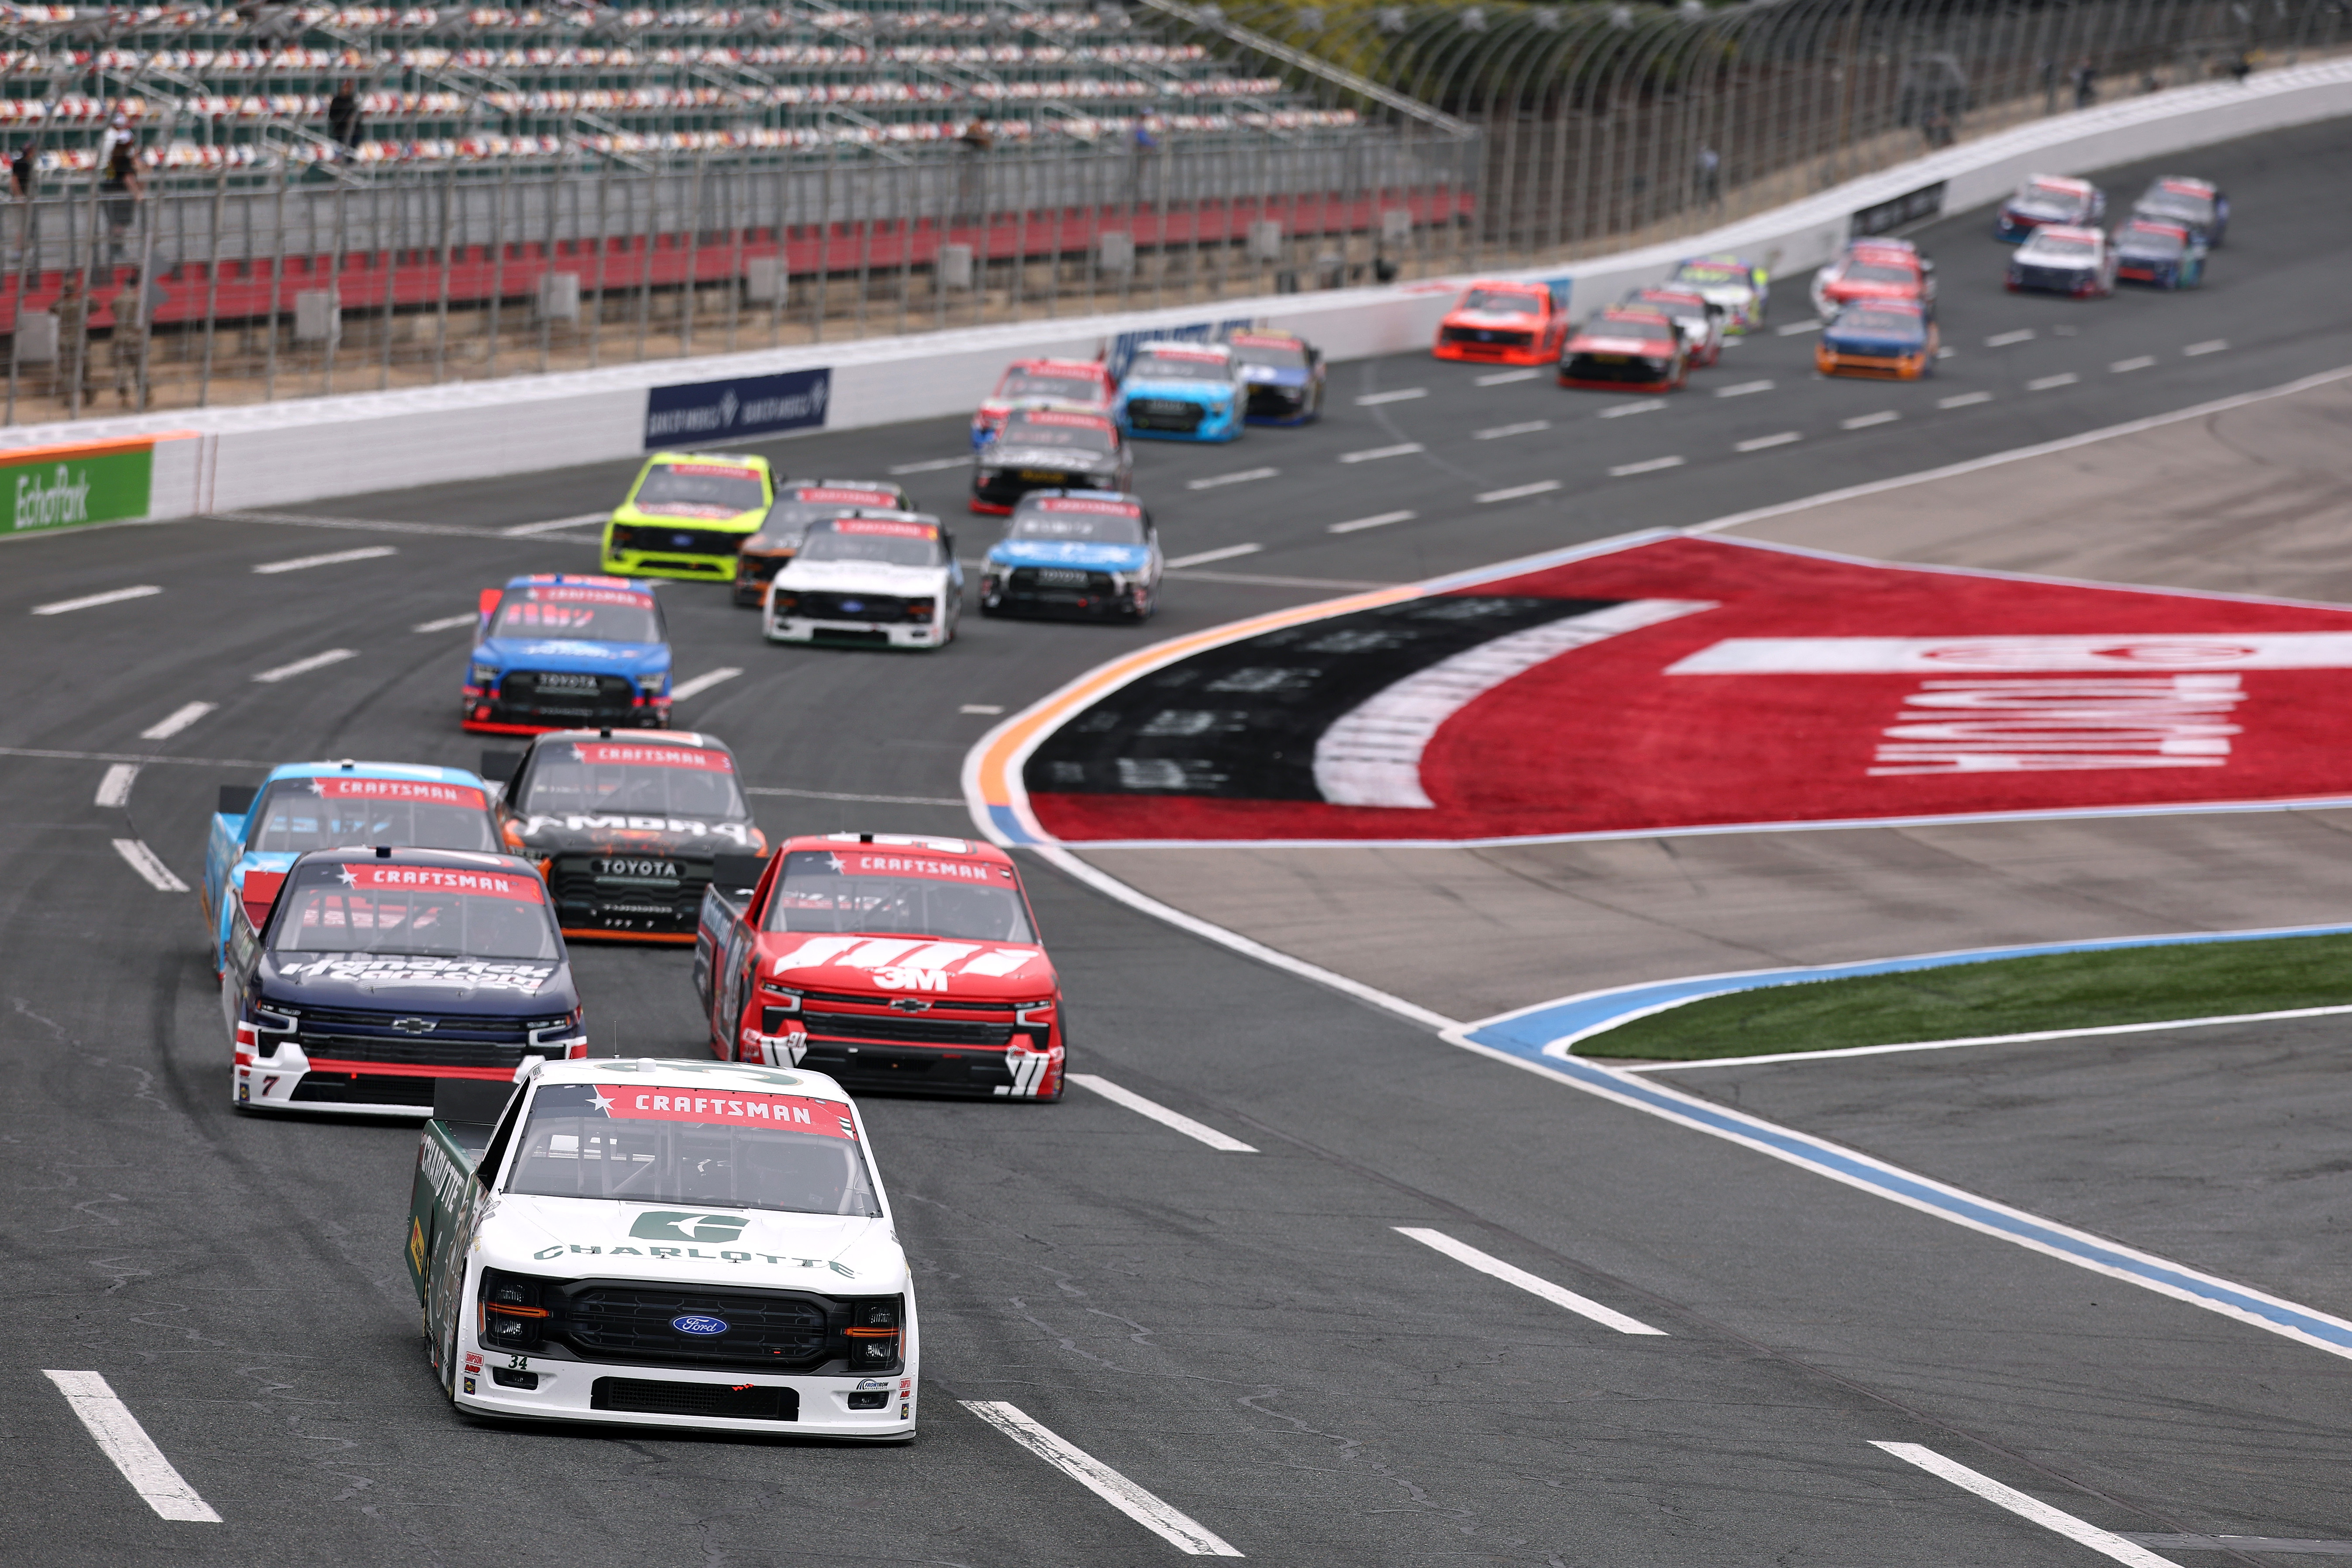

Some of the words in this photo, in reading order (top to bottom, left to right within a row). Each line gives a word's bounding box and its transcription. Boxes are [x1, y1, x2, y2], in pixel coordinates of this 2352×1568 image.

[15, 463, 90, 529] EchoPark
[539, 673, 597, 689] TOYOTA
[598, 748, 706, 766] CRAFTSMAN
[340, 781, 458, 801] CRAFTSMAN
[601, 859, 677, 877] TOYOTA
[860, 857, 988, 880] CRAFTSMAN
[373, 870, 510, 892] CRAFTSMAN
[872, 966, 948, 992] 3M
[787, 1031, 808, 1048] 91
[262, 1075, 280, 1097] 7
[635, 1094, 812, 1125] CRAFTSMAN
[422, 1135, 463, 1213] CHARLOTTE
[534, 1244, 856, 1279] CHARLOTTE
[682, 1318, 718, 1332] Ford
[465, 1364, 481, 1374] ARP
[466, 1353, 482, 1365] SIMPSON
[508, 1354, 528, 1370] 34
